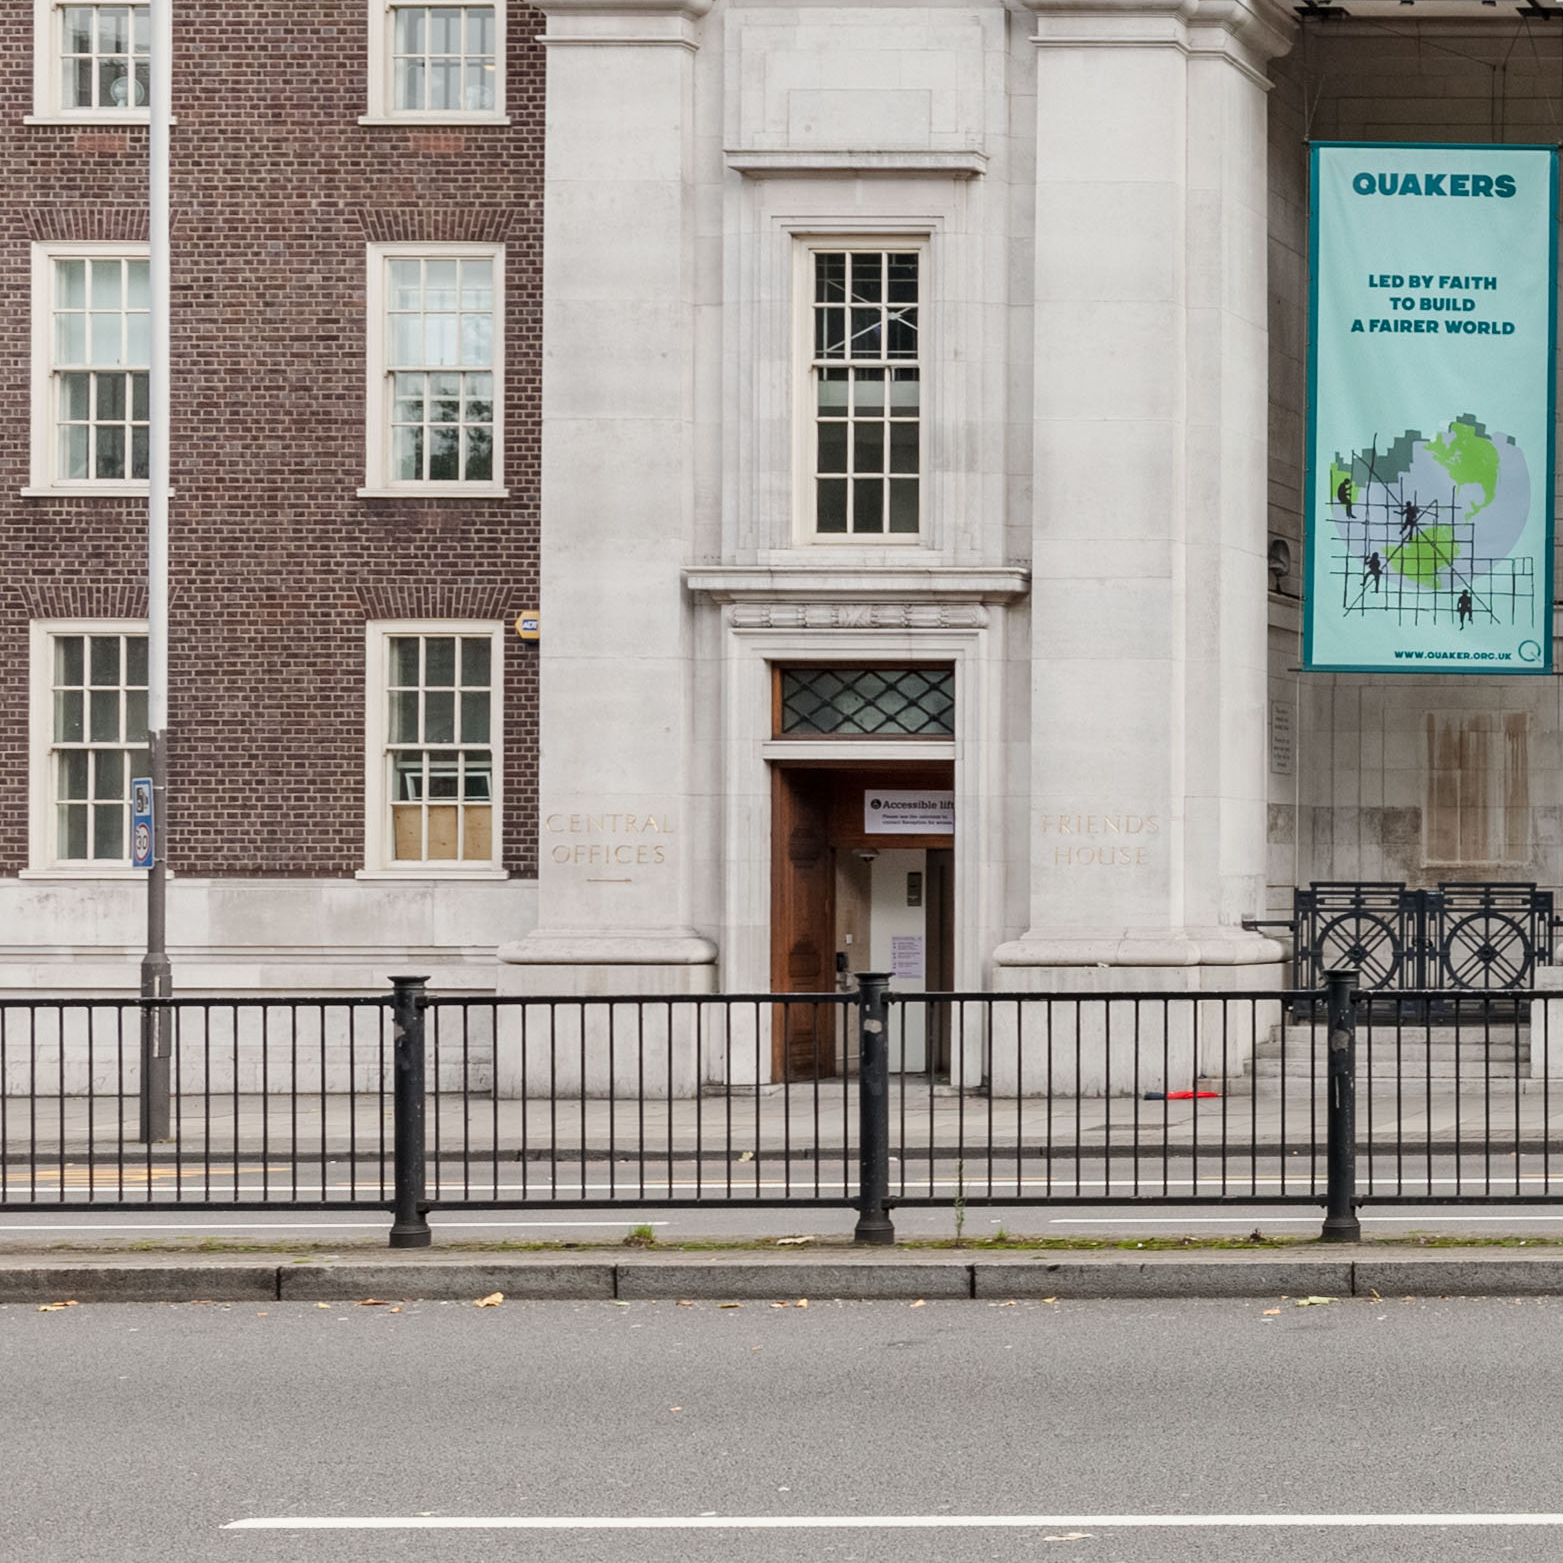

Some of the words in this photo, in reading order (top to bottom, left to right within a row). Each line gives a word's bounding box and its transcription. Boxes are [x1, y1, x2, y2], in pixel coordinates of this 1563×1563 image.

[1352, 172, 1518, 198] QUAKERS
[1368, 274, 1404, 288] LED
[1409, 275, 1434, 289] BY
[1439, 276, 1497, 290] FAITH
[1390, 297, 1416, 311] TO
[1420, 298, 1476, 312] BUILD
[1351, 319, 1365, 333] A
[1369, 319, 1439, 333] FAIRER
[1444, 320, 1516, 335] WORLD
[883, 800, 937, 809] Accessible
[545, 813, 675, 833] CENTRAL
[1041, 814, 1159, 834] FRIENDS
[552, 844, 665, 864] OFFICES
[1054, 845, 1148, 865] HOUSE
